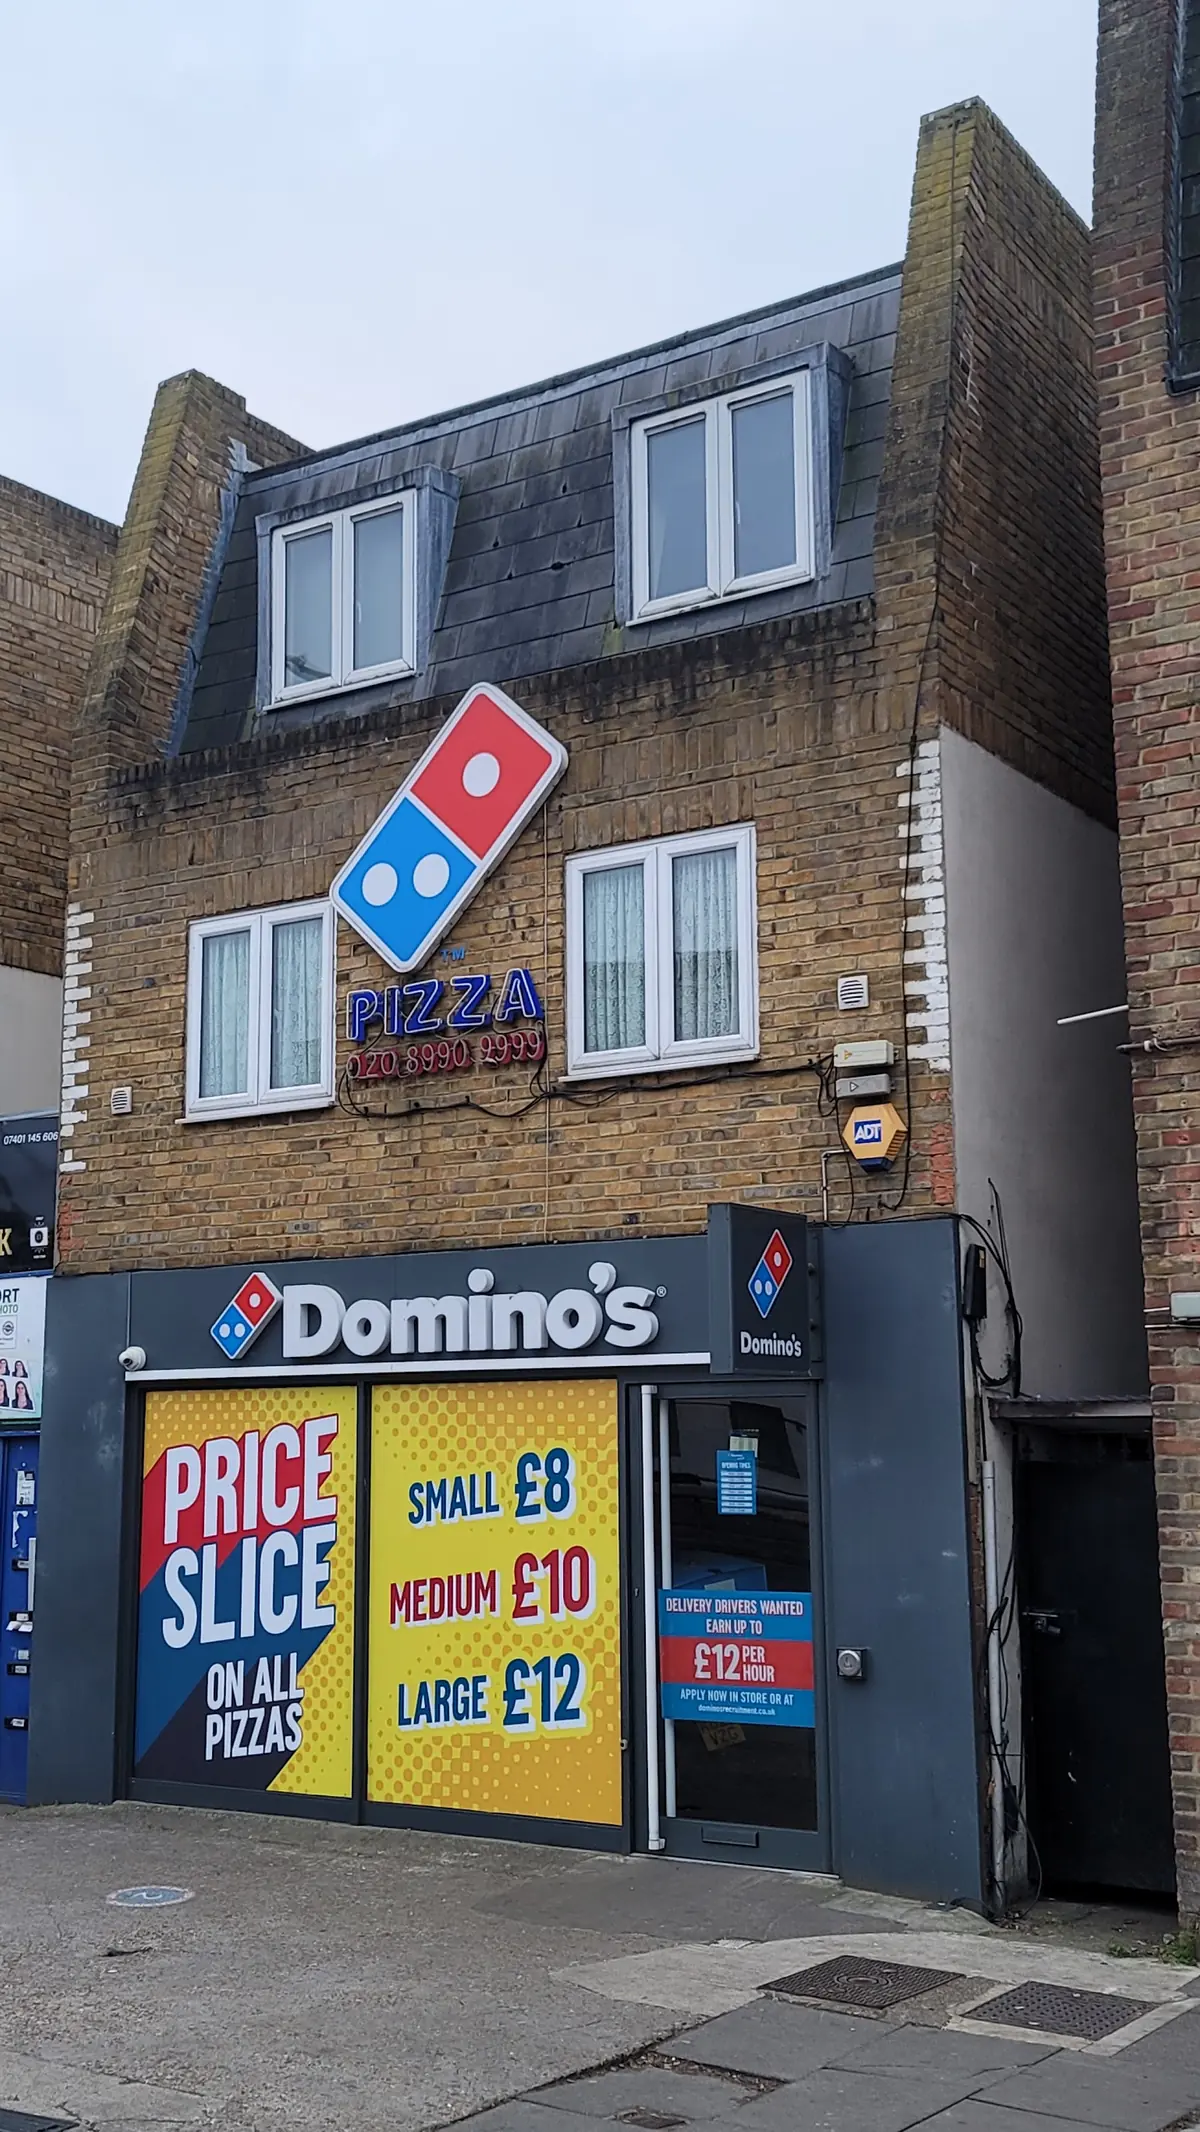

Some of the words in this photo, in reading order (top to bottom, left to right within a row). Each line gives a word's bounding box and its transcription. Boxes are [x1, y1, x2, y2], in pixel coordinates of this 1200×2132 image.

[440, 946, 465, 962] TM
[346, 967, 545, 1043] PIZZA
[346, 1050, 399, 1079] 020
[406, 1038, 472, 1075] 8990
[3, 1134, 26, 1145] 07401
[28, 1132, 42, 1143] 145
[42, 1131, 59, 1142] 606
[854, 1122, 881, 1141] ADT
[0, 1288, 20, 1303] RT
[282, 1261, 659, 1358] Domino's
[740, 1331, 802, 1357] Domino's
[163, 1413, 339, 1545] PRICE
[408, 1471, 501, 1526] SMALL
[514, 1447, 572, 1520] £8
[162, 1521, 337, 1649] SLICE
[389, 1569, 498, 1626] MEDIUM
[511, 1545, 592, 1621] £10
[666, 1597, 713, 1613] DELIVERY
[715, 1599, 758, 1614] DRIVERS
[760, 1600, 804, 1615] WANTED
[706, 1618, 732, 1634] EARN
[733, 1619, 747, 1634] UP
[750, 1620, 763, 1635] TO
[694, 1642, 741, 1680] £12
[742, 1645, 766, 1663] PER
[206, 1659, 245, 1710] ON
[252, 1652, 304, 1704] ALL
[742, 1664, 776, 1682] HOUR
[397, 1674, 488, 1728] LARGE
[502, 1652, 583, 1728] £12
[680, 1688, 707, 1701] APPLY
[707, 1689, 728, 1702] NOW
[729, 1690, 739, 1703] IN
[740, 1691, 767, 1704] STORE
[769, 1693, 782, 1705] OR
[783, 1694, 794, 1706] AT
[698, 1704, 776, 1716] dominosrecruitment.co.uk
[204, 1703, 303, 1761] PIZZAS
